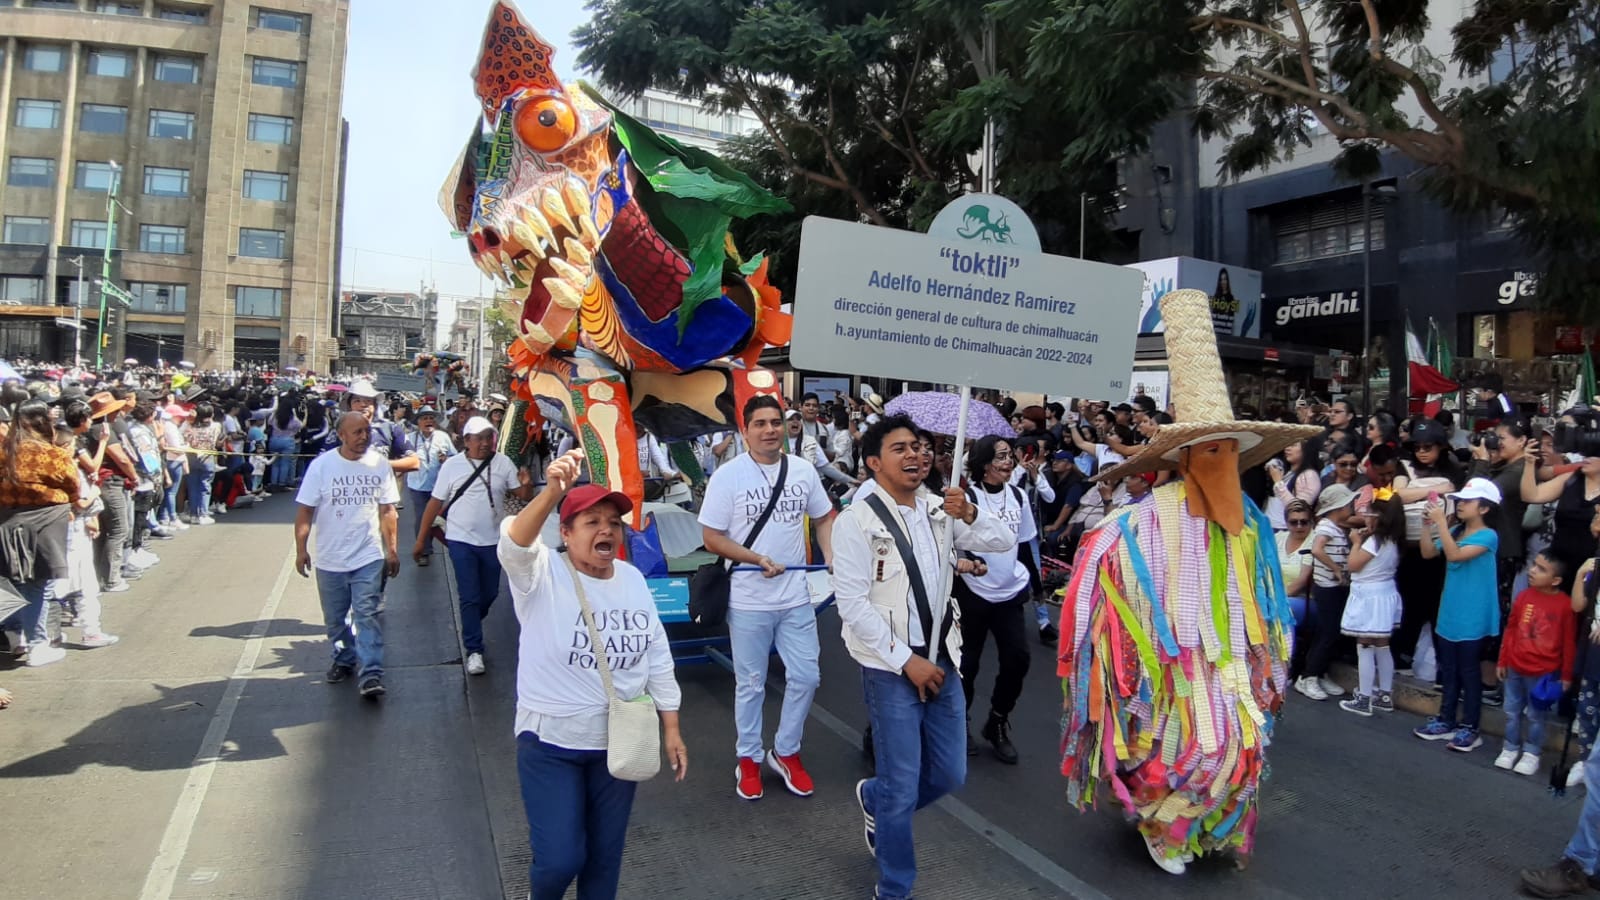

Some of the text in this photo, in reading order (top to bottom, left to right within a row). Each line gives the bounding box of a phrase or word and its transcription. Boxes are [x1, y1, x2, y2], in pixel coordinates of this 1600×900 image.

[868, 270, 921, 293] Adelfo
[926, 278, 1010, 306] Hernández
[834, 297, 1098, 343] dirección general de cultura de chimalhuacán
[1275, 291, 1359, 325] gandhi
[835, 322, 930, 346] h.ayuntamiento
[934, 335, 948, 348] de
[1035, 347, 1092, 365] 2022-2024
[333, 475, 382, 487] MUSEO
[333, 487, 349, 498] DE
[746, 484, 803, 501] MUEO
